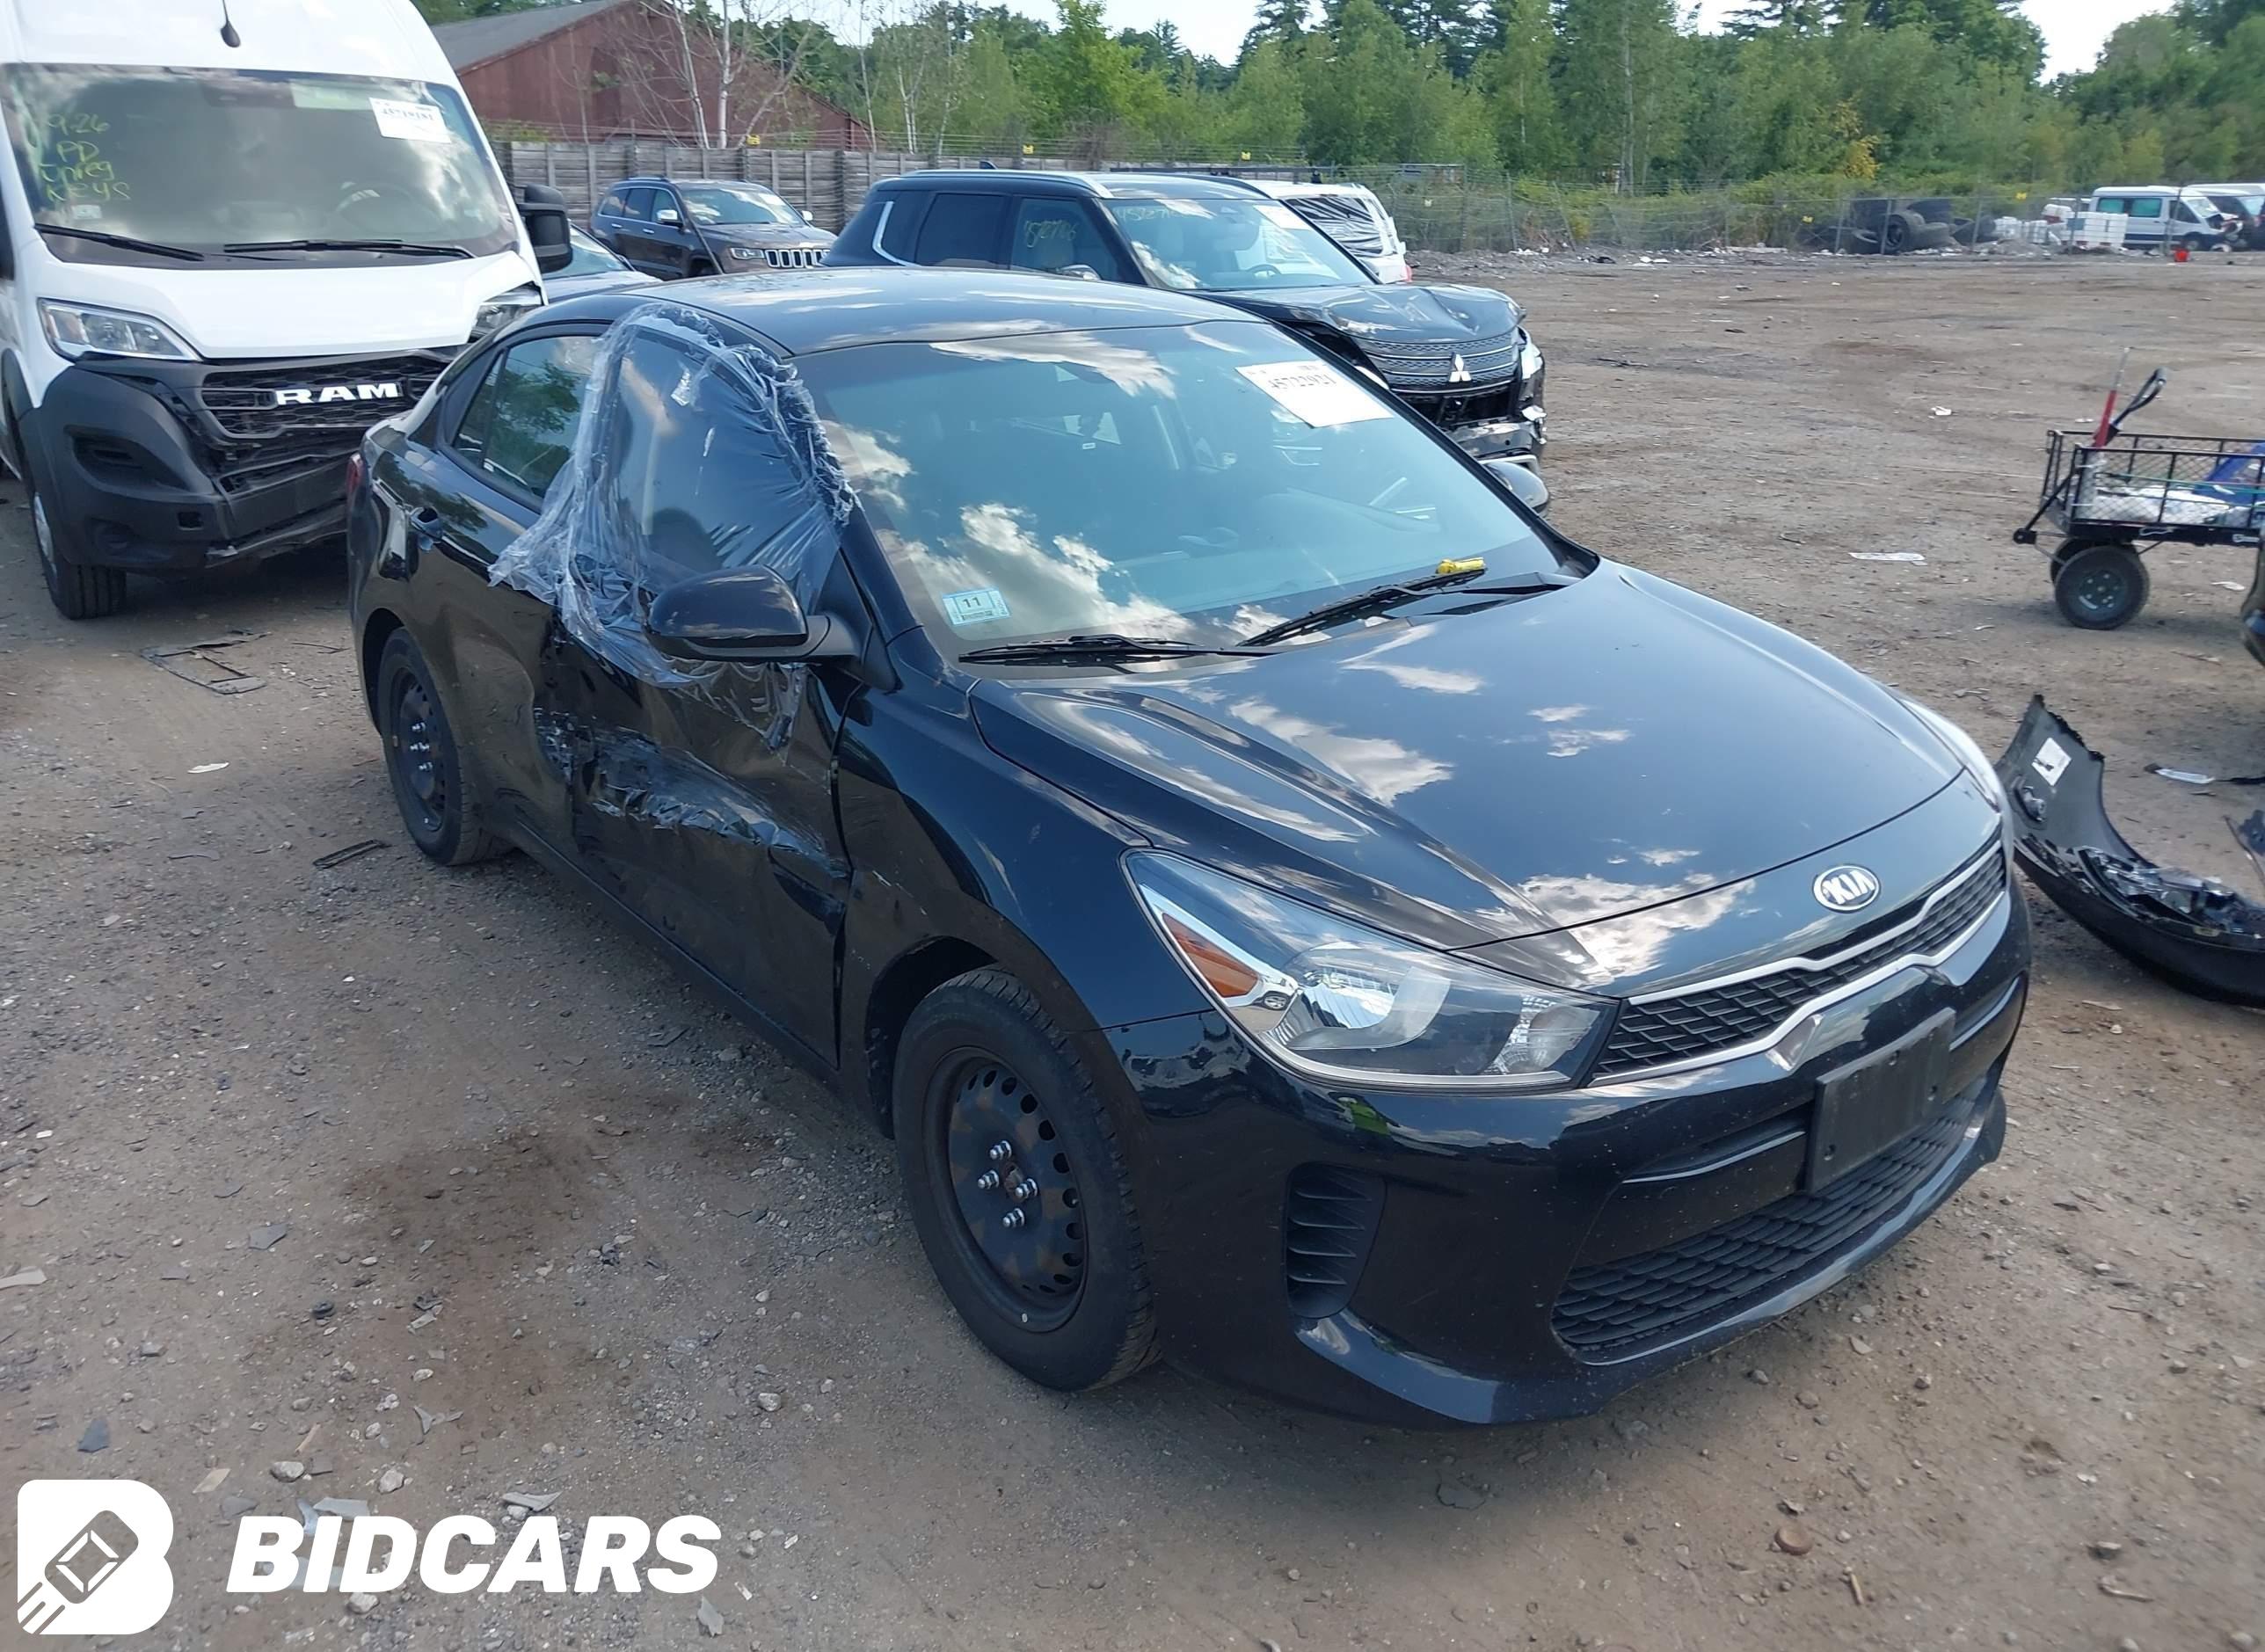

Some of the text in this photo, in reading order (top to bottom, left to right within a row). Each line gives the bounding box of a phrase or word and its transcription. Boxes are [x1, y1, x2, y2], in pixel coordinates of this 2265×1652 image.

[56, 140, 99, 163] PD
[275, 382, 398, 405] RAM
[963, 596, 982, 608] 11
[1821, 870, 1875, 905] KIA
